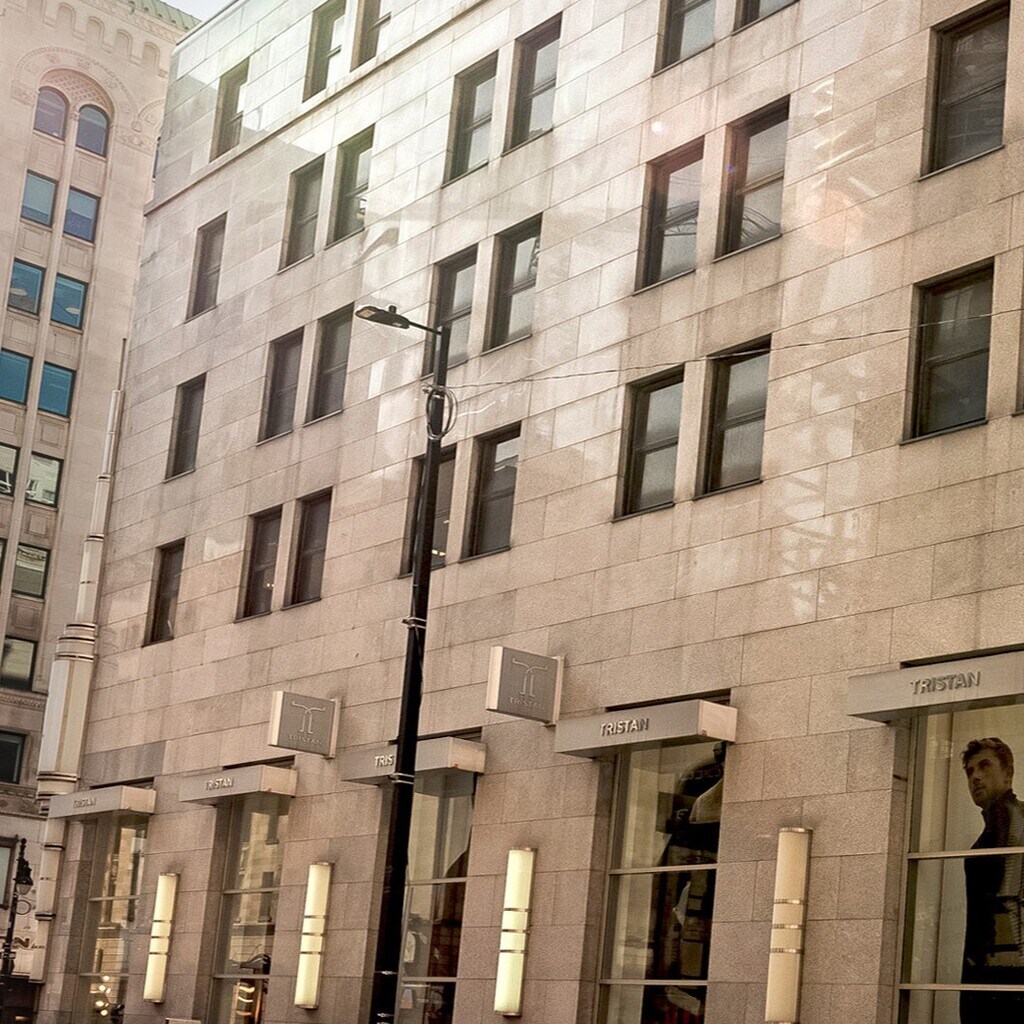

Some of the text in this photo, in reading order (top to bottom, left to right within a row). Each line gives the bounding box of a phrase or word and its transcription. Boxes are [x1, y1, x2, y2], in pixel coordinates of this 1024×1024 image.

[909, 670, 981, 695] TRISTAN
[600, 717, 649, 737] TRISTAN
[374, 754, 395, 767] TRIS
